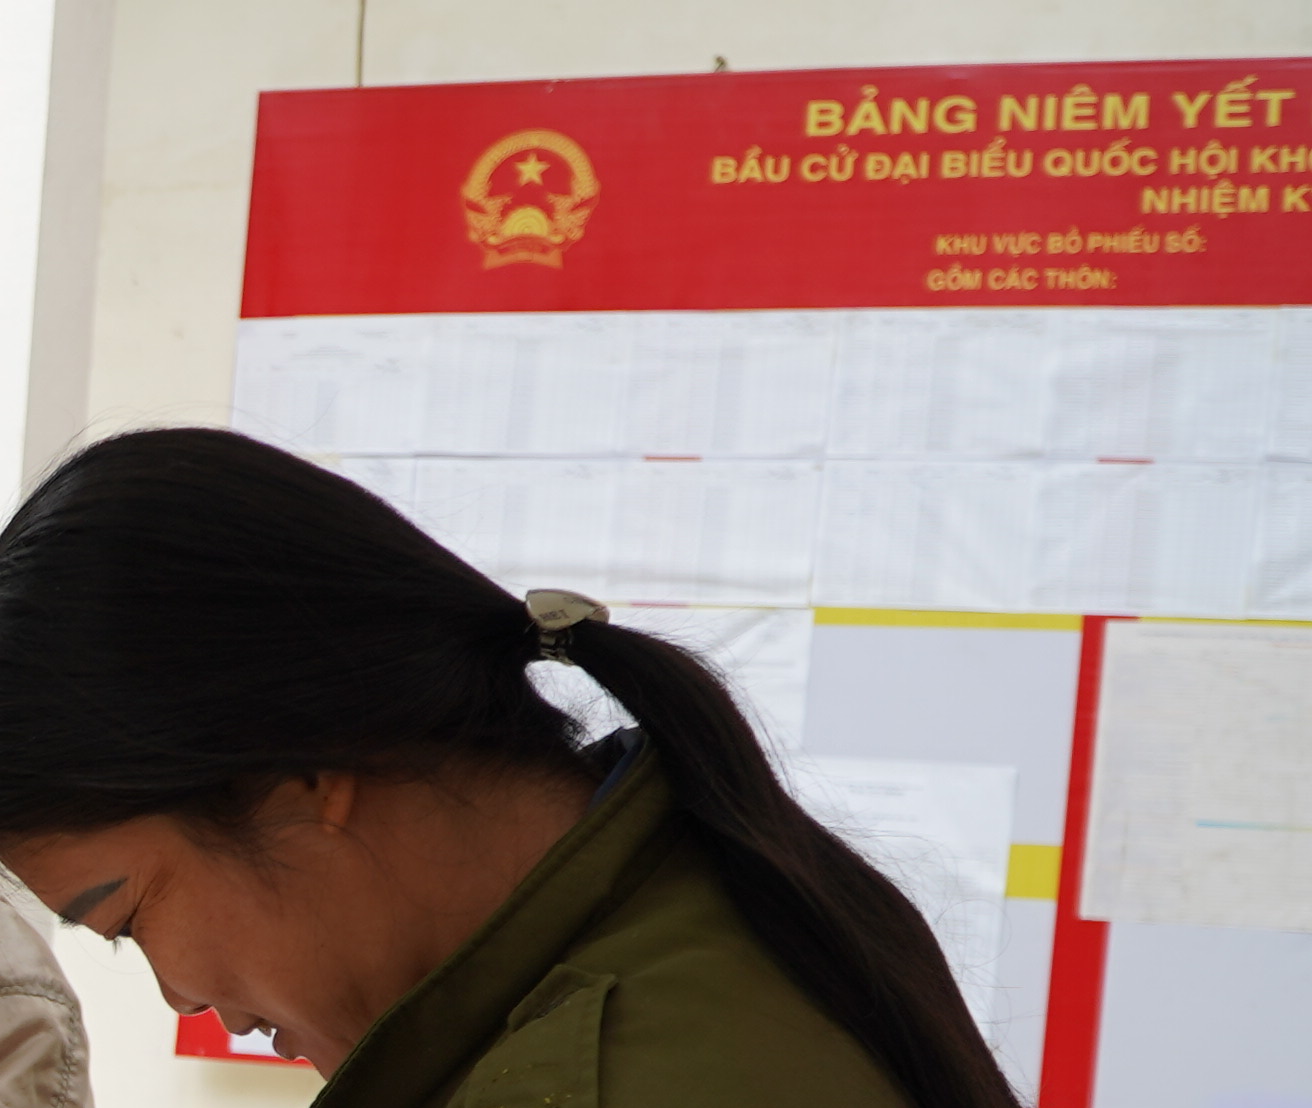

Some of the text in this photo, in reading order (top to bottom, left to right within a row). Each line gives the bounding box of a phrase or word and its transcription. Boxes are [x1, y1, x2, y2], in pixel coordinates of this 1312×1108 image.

[805, 75, 1296, 137] BẢNG NIÊM YẾT
[800, 144, 859, 182] CỬ
[864, 151, 930, 184] ĐẠI
[940, 135, 1033, 179] BIỂU
[1044, 137, 1158, 177] QUỐC
[1169, 139, 1239, 179] HỘI
[1249, 145, 1312, 174] KH
[1141, 178, 1312, 218] NHIỆM K
[935, 224, 1207, 257] KHU VỰC BỎ PHIẾU SỐ:
[987, 265, 1040, 290] CÁC
[1043, 264, 1118, 289] THÔN:
